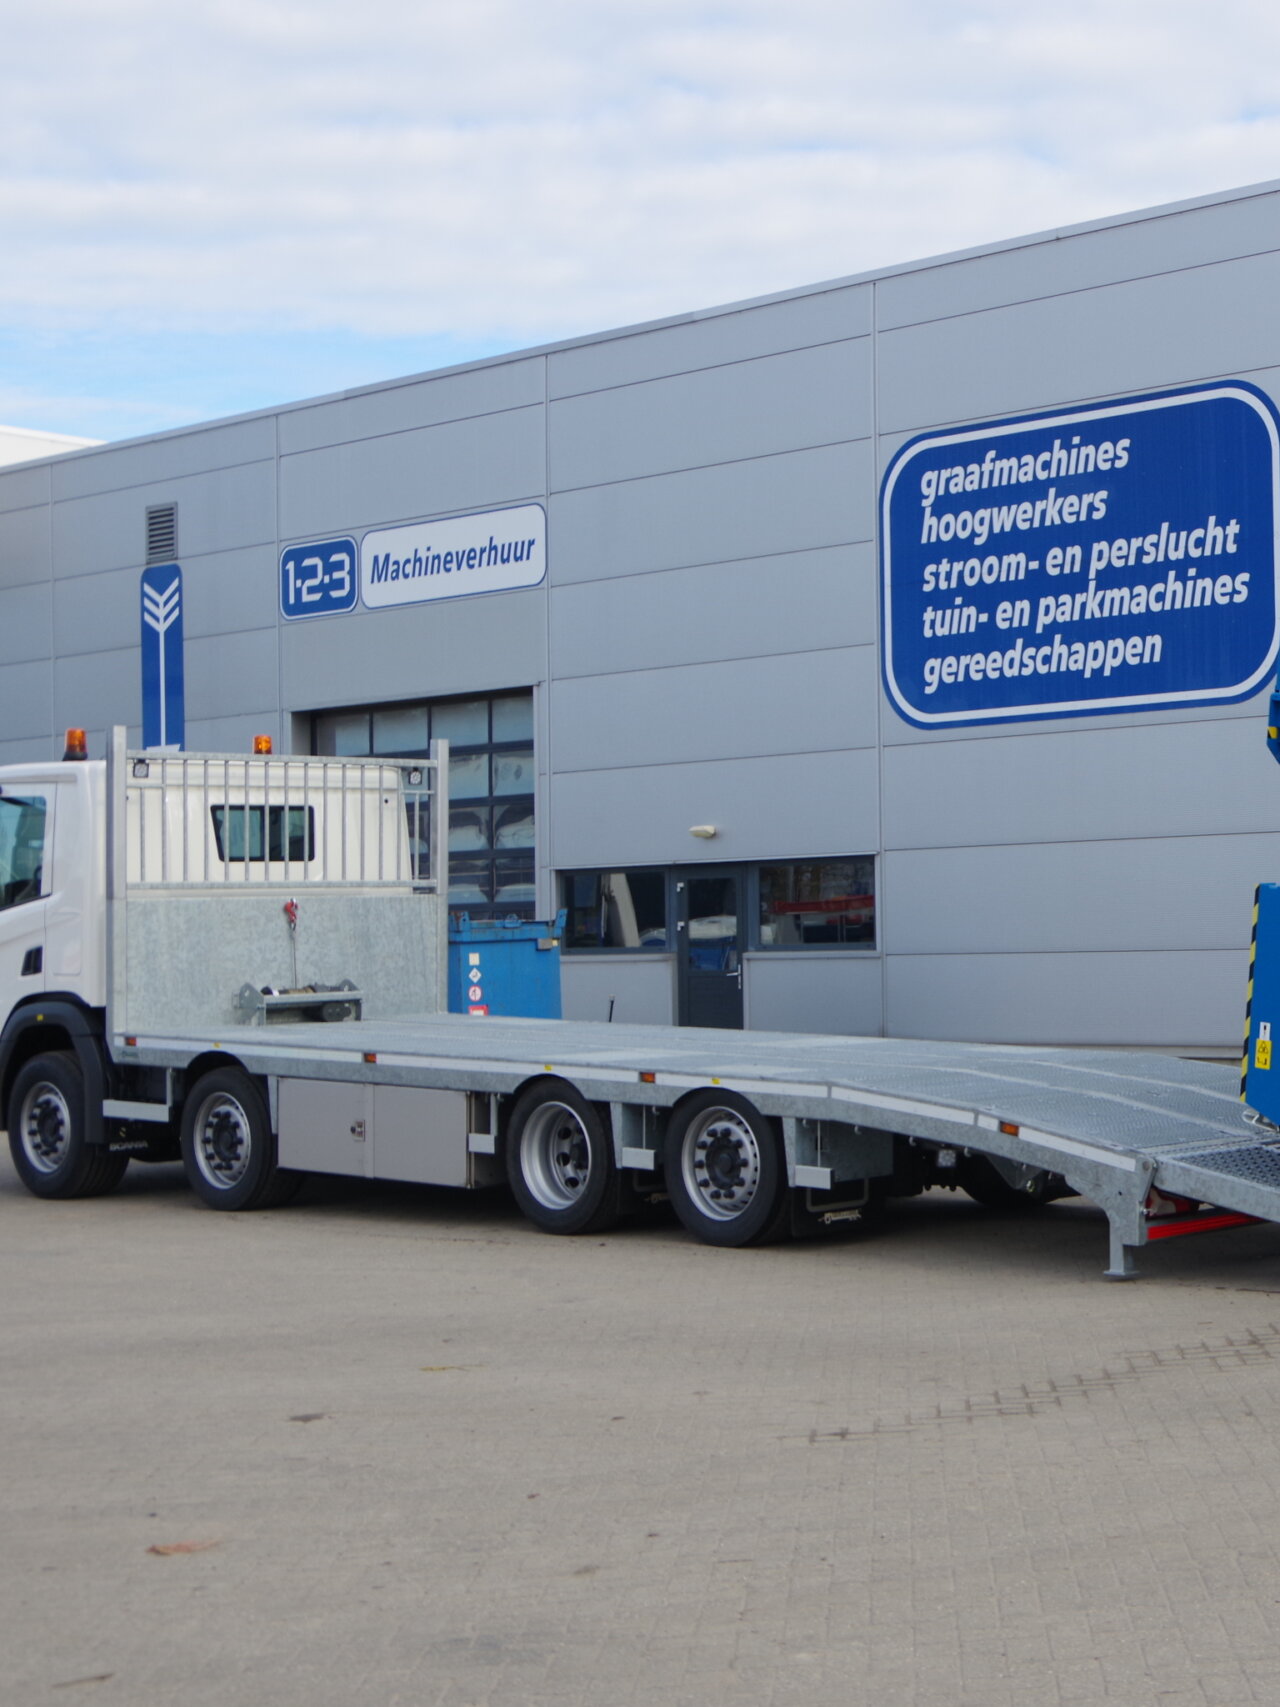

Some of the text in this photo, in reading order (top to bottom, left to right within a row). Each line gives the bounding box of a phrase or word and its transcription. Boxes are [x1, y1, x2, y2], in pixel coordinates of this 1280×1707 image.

[920, 435, 1131, 507] graafmachines
[920, 487, 1108, 545] hoogwerkers
[370, 535, 536, 585] Machineverhuur
[921, 514, 1240, 592] stroom- en perslucht
[922, 567, 1251, 638] tuin- en parkmachines
[923, 633, 1163, 695] gereedschappen
